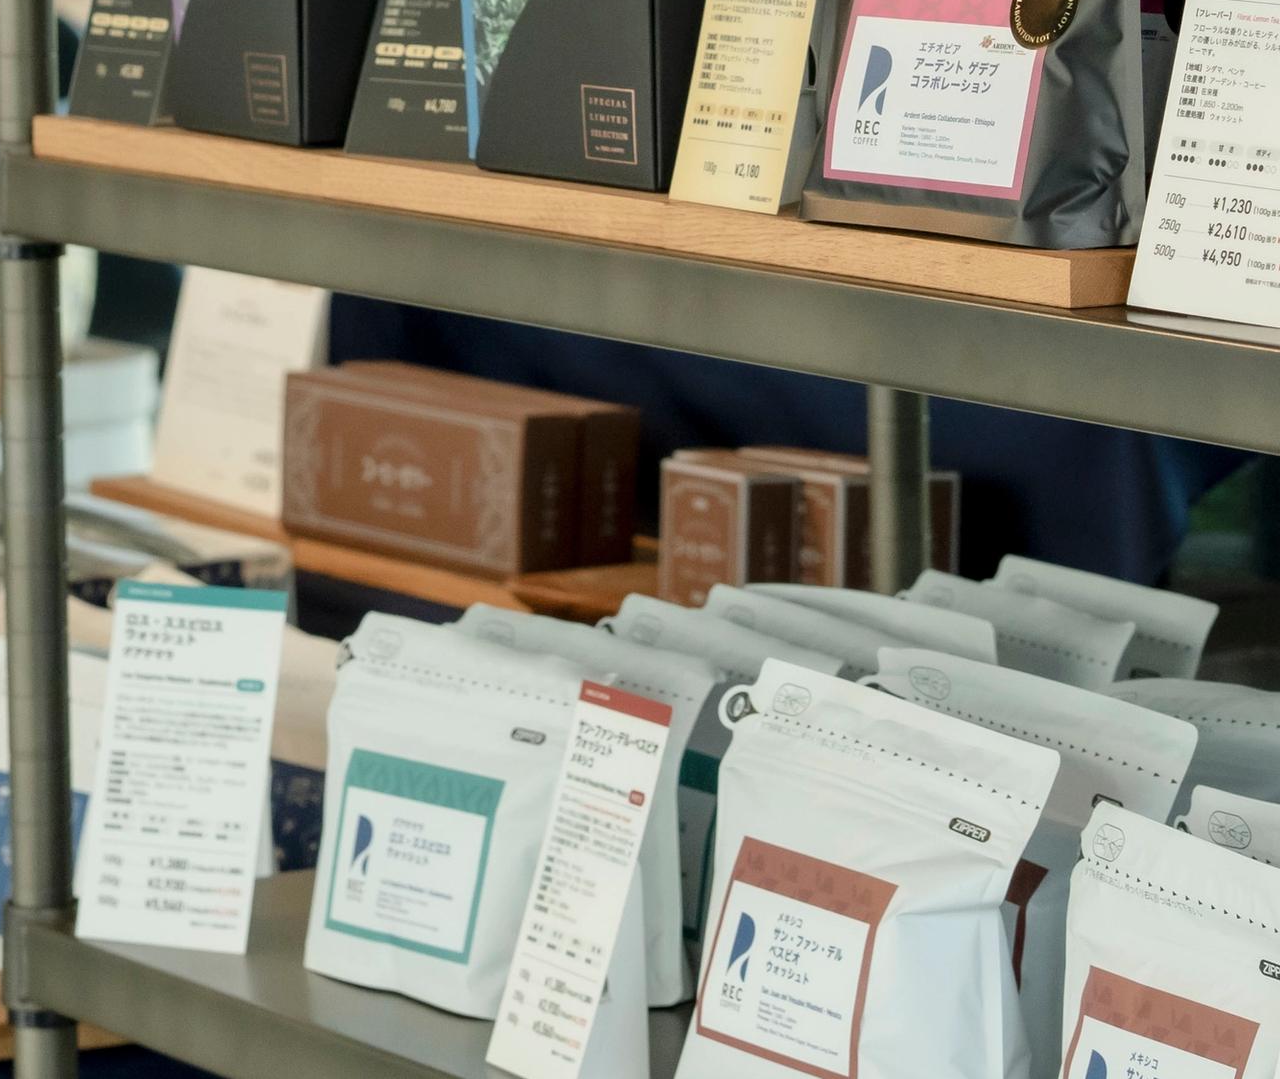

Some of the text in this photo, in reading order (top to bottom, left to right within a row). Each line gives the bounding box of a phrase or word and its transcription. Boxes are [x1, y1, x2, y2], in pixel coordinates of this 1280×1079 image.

[919, 42, 962, 55] エチオピア
[913, 58, 999, 77] アーデント ゲデブ
[910, 75, 992, 94] コラボレーション
[588, 96, 627, 109] SPECIAL
[589, 112, 628, 126] LIMITED
[854, 120, 880, 136] REC
[590, 129, 628, 141] SELECTION
[853, 137, 878, 147] COFFEE
[1165, 192, 1252, 215] 100g ¥1,230
[1158, 218, 1247, 241] 250g ¥2,610
[1153, 244, 1242, 267] 500g ¥4,950
[952, 820, 988, 842] ZIPPER
[777, 913, 804, 928] メキシコ
[766, 961, 809, 985] ウォッシュト
[722, 982, 743, 1002] REC
[1129, 1050, 1159, 1070] メキシコ
